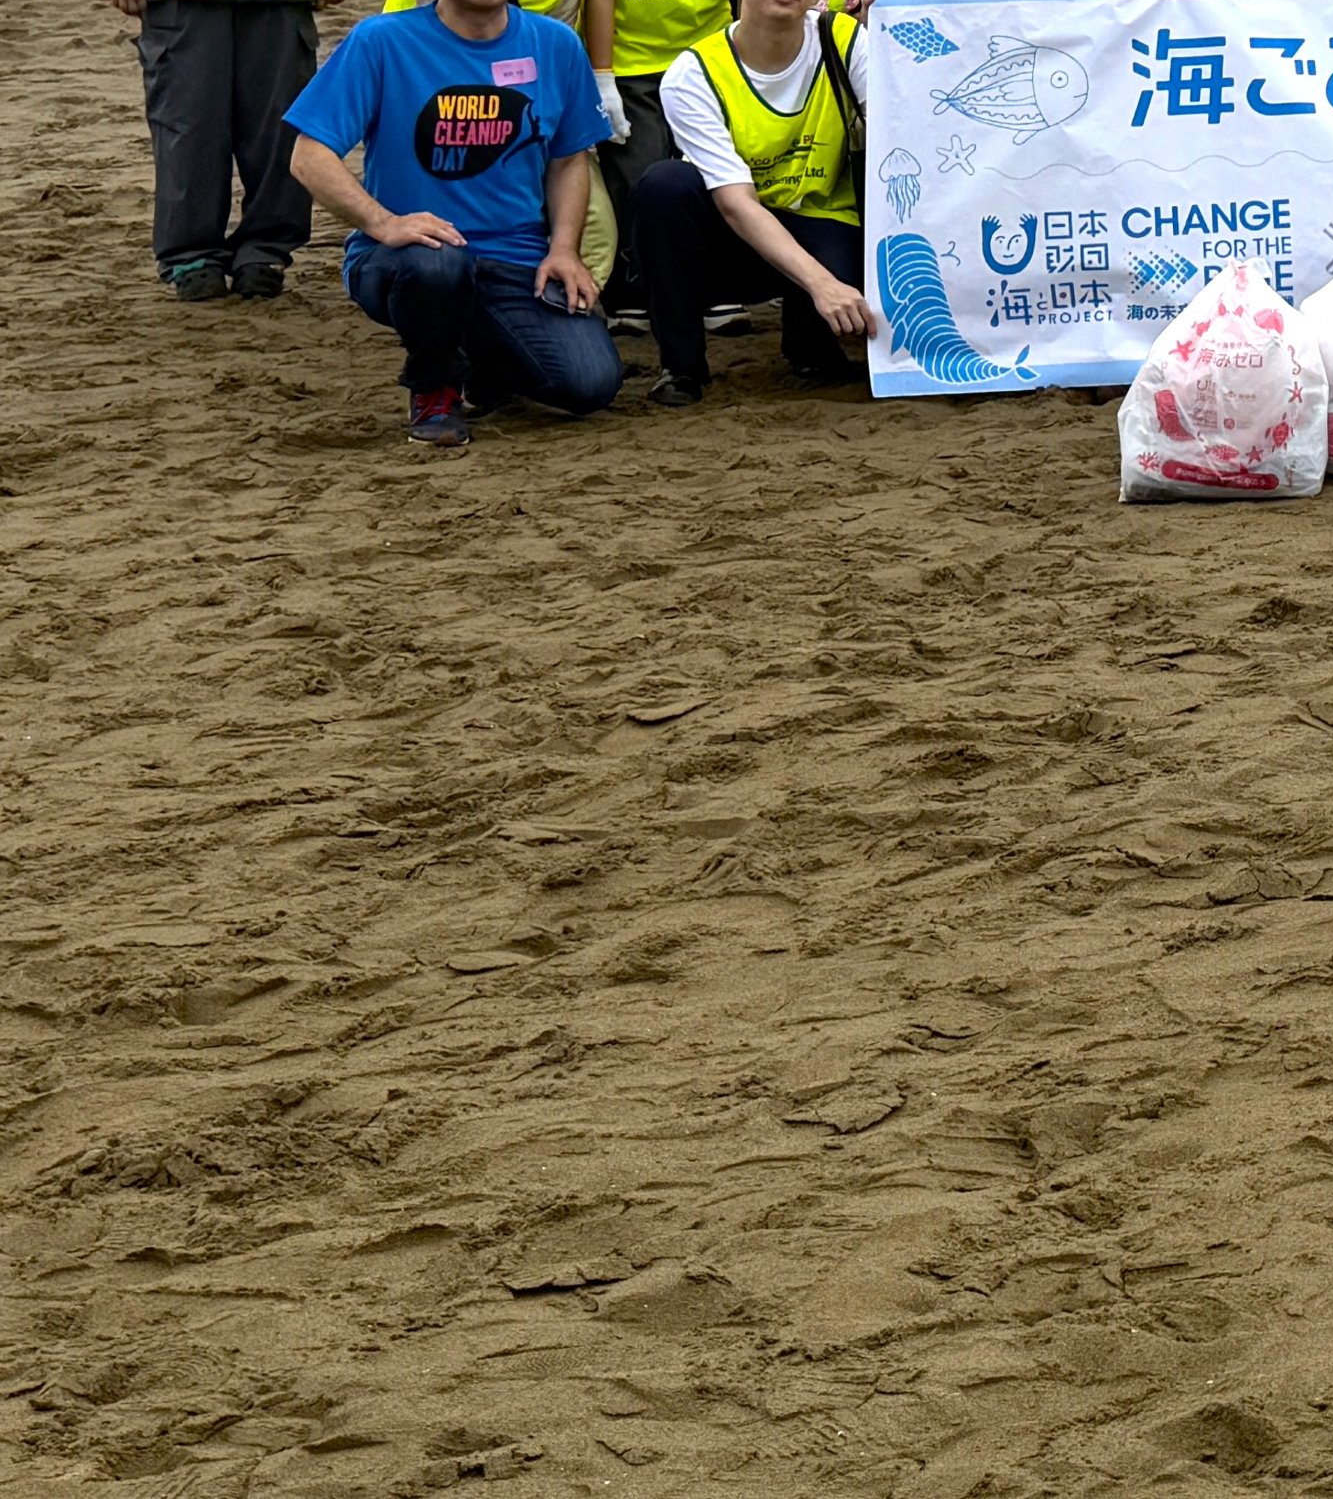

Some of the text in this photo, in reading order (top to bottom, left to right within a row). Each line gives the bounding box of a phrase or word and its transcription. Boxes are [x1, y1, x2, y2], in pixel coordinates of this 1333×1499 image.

[437, 95, 500, 120] WORLD
[434, 120, 513, 146] CLEANUP
[431, 146, 468, 172] DAY
[1044, 209, 1109, 240] 日本
[1121, 199, 1291, 239] CHANGE
[1045, 243, 1110, 274] 財団
[1203, 236, 1292, 258] FOR THE
[1203, 260, 1294, 291] BE
[1037, 309, 1113, 326] PROJECT
